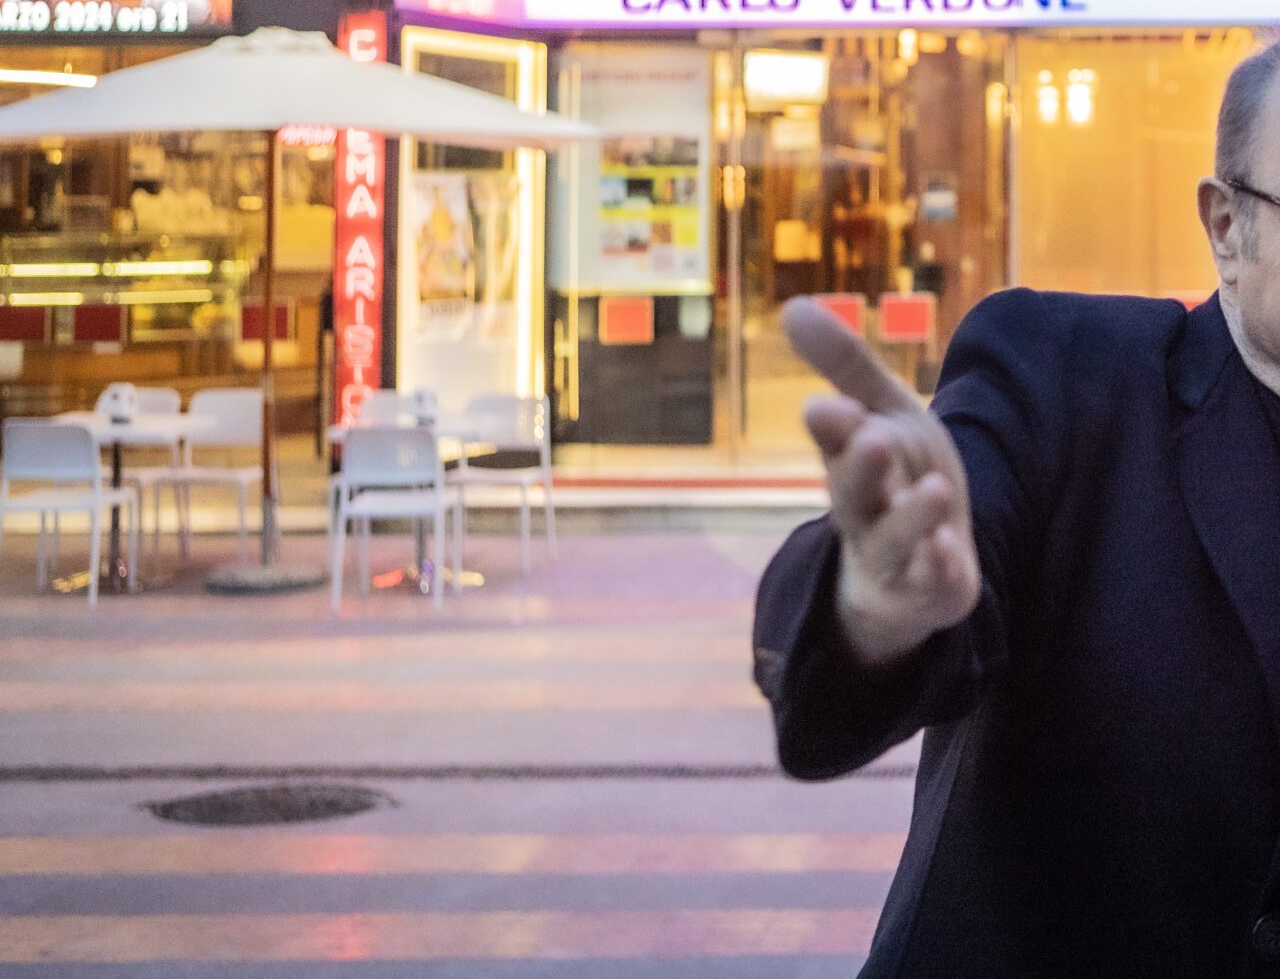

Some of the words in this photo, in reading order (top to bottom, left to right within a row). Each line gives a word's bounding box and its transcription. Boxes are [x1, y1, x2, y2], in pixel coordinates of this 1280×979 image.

[54, 0, 114, 32] 2024
[159, 0, 190, 32] 21
[344, 28, 378, 219] CEMA
[341, 235, 377, 430] ARISTO
